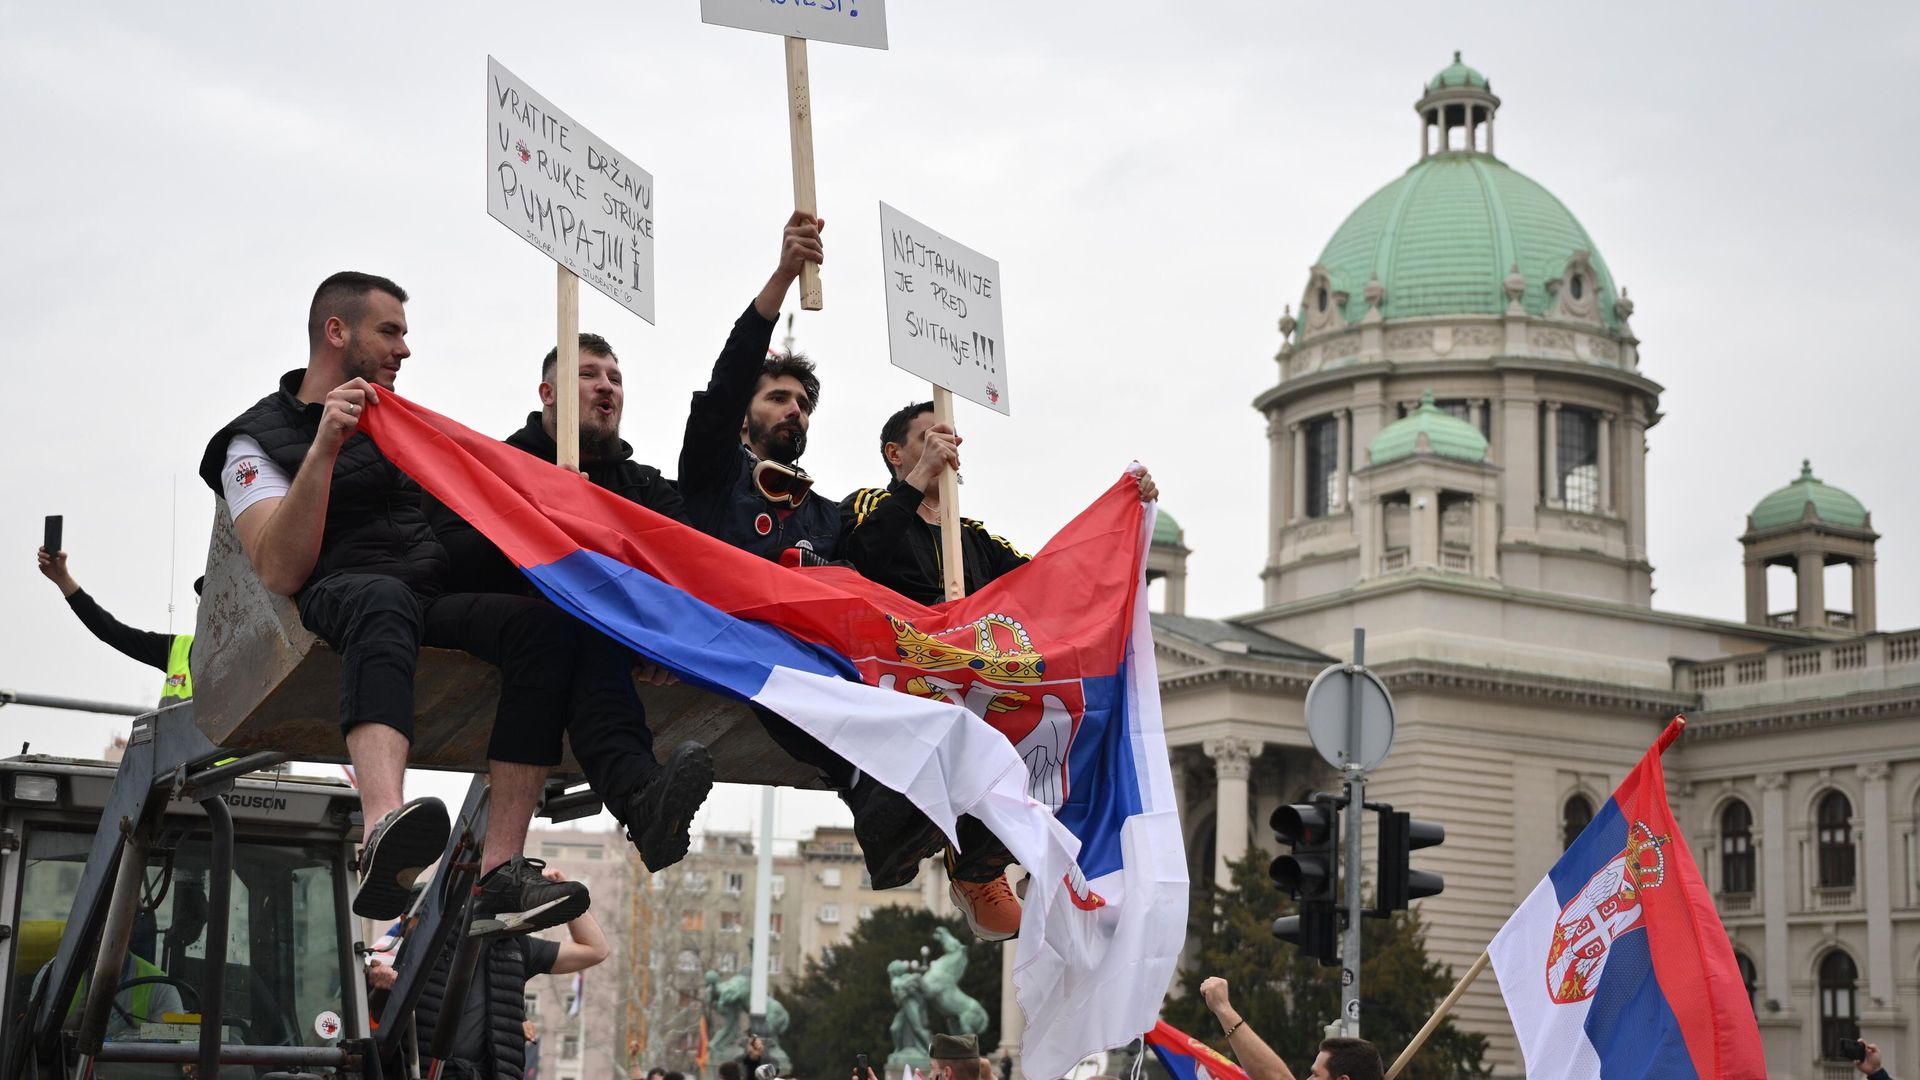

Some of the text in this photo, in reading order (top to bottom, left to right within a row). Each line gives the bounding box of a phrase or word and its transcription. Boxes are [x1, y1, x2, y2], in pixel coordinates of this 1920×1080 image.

[494, 74, 650, 210] VRATITE DRŽAVU
[498, 121, 510, 153] U
[536, 149, 587, 200] RUKE
[601, 192, 654, 240] STRUKE
[891, 227, 993, 299] NAJTAMNIJE
[894, 270, 968, 319] JE PRED
[905, 310, 996, 374] SVITANJE!!!
